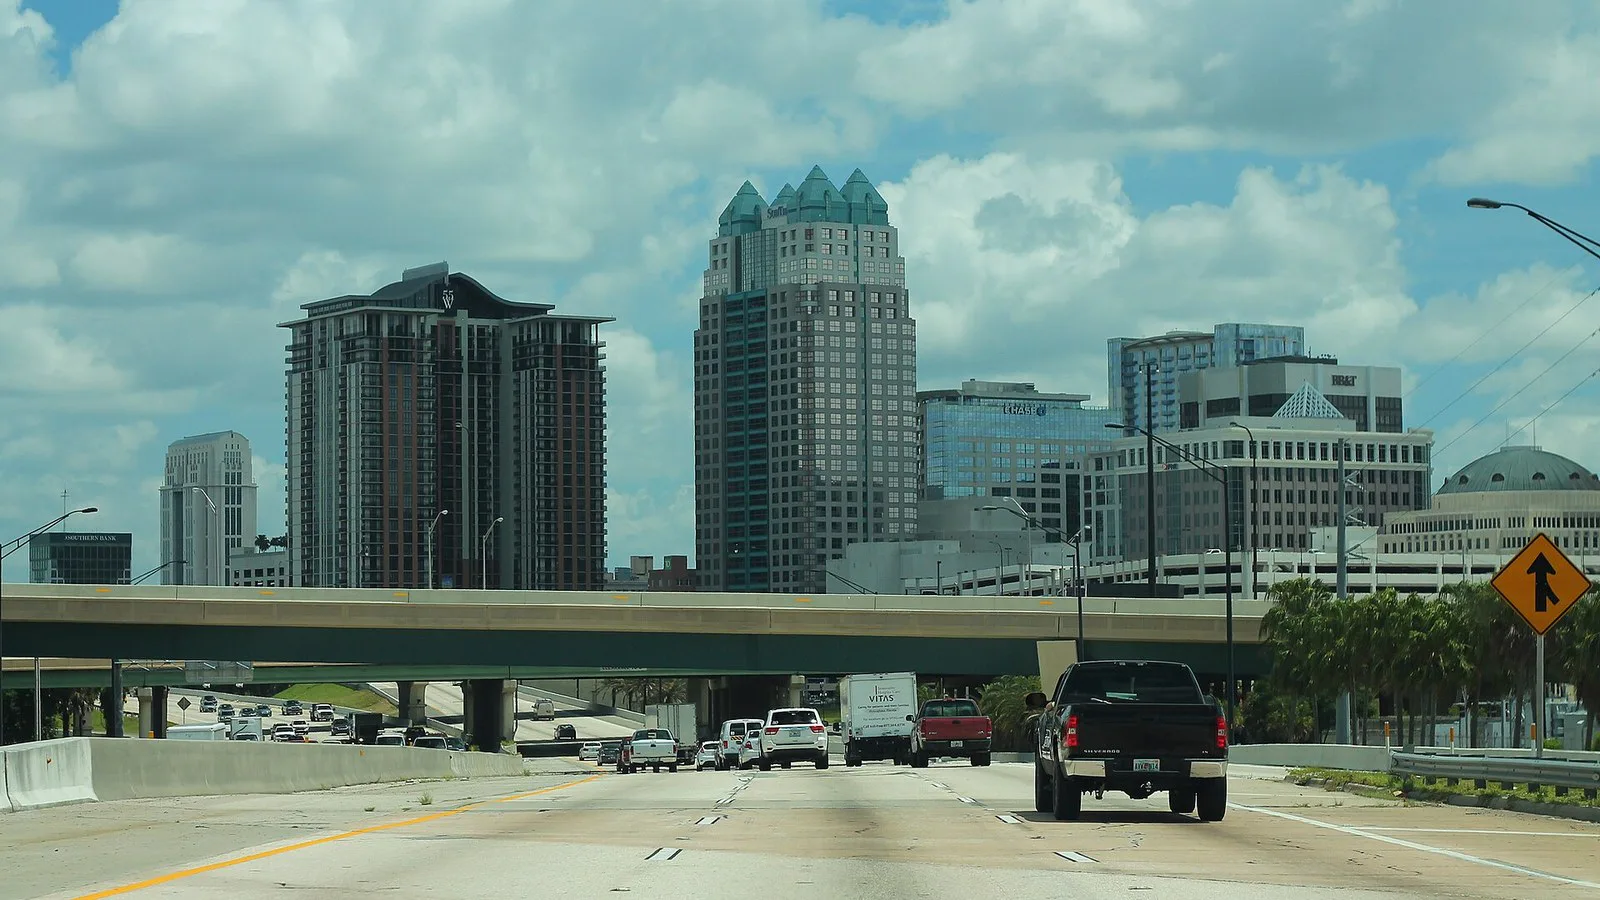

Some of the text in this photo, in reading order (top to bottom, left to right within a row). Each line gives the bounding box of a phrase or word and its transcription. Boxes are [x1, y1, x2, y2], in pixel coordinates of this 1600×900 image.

[1331, 374, 1358, 387] BB&T
[1003, 404, 1036, 416] CHASE
[869, 694, 894, 702] VITAS
